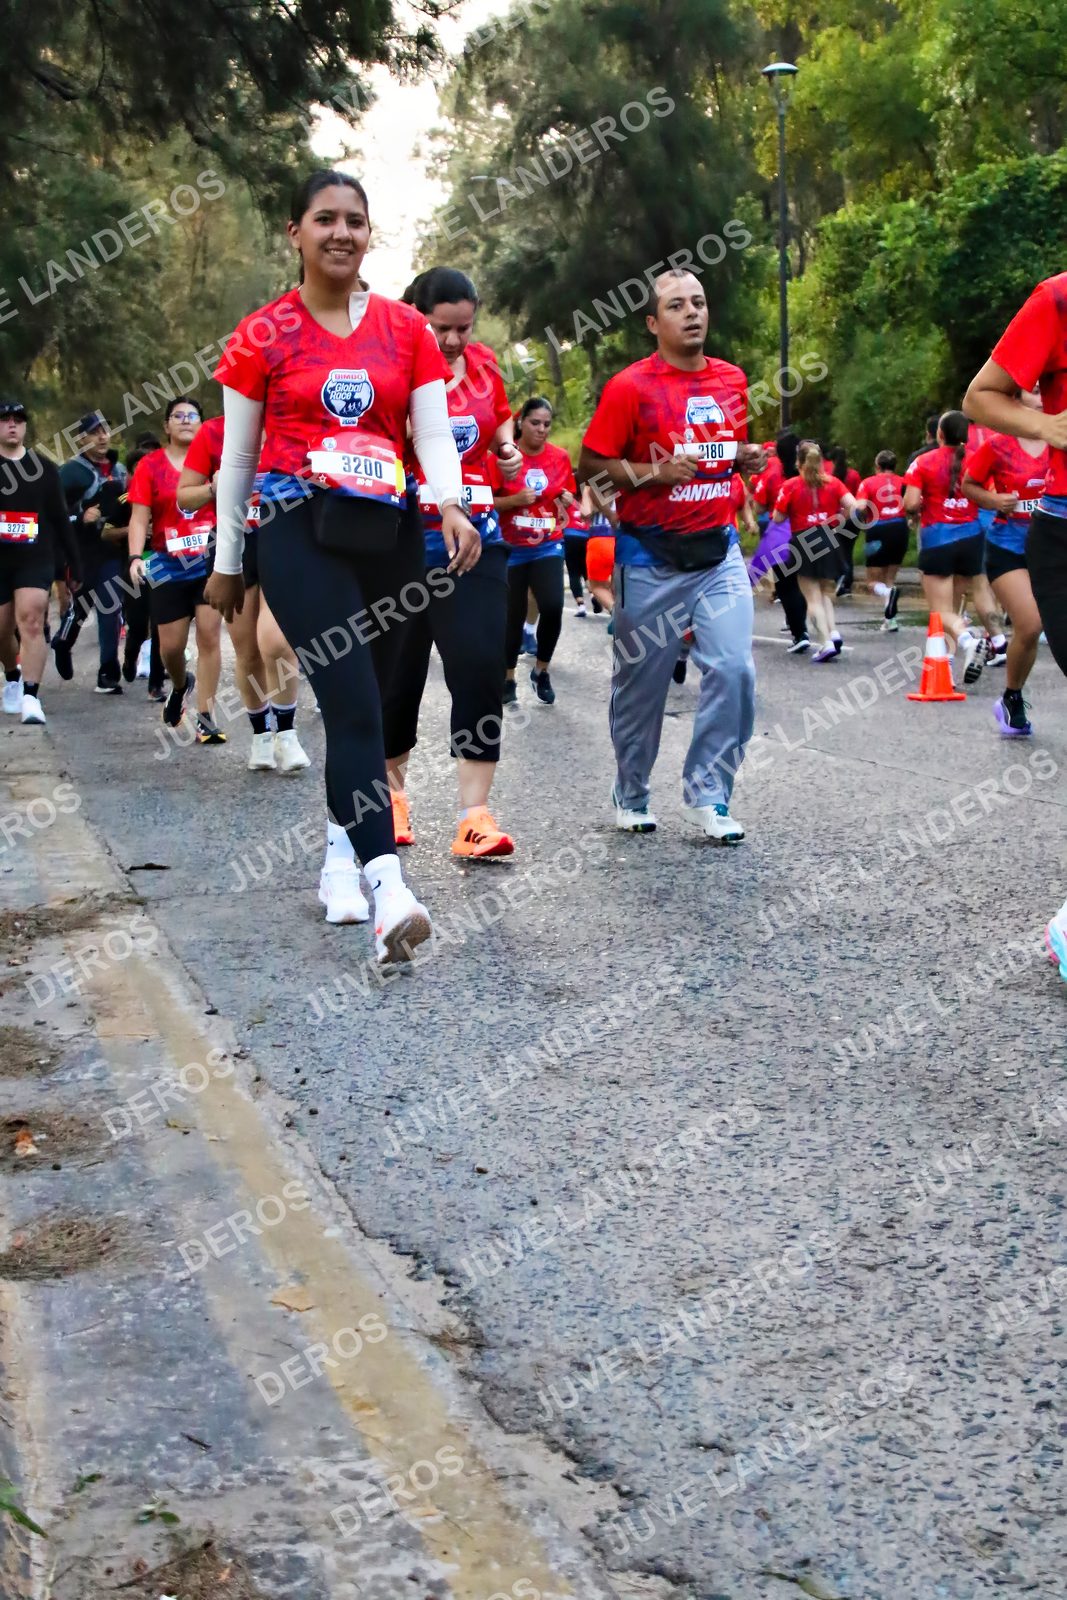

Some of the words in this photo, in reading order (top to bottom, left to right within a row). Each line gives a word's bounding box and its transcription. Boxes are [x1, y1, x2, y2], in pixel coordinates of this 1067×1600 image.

[335, 383, 363, 393] Global
[330, 391, 352, 400] Race
[341, 455, 383, 479] 3200
[669, 481, 731, 502] SANTIAGO
[7, 523, 26, 533] 3273
